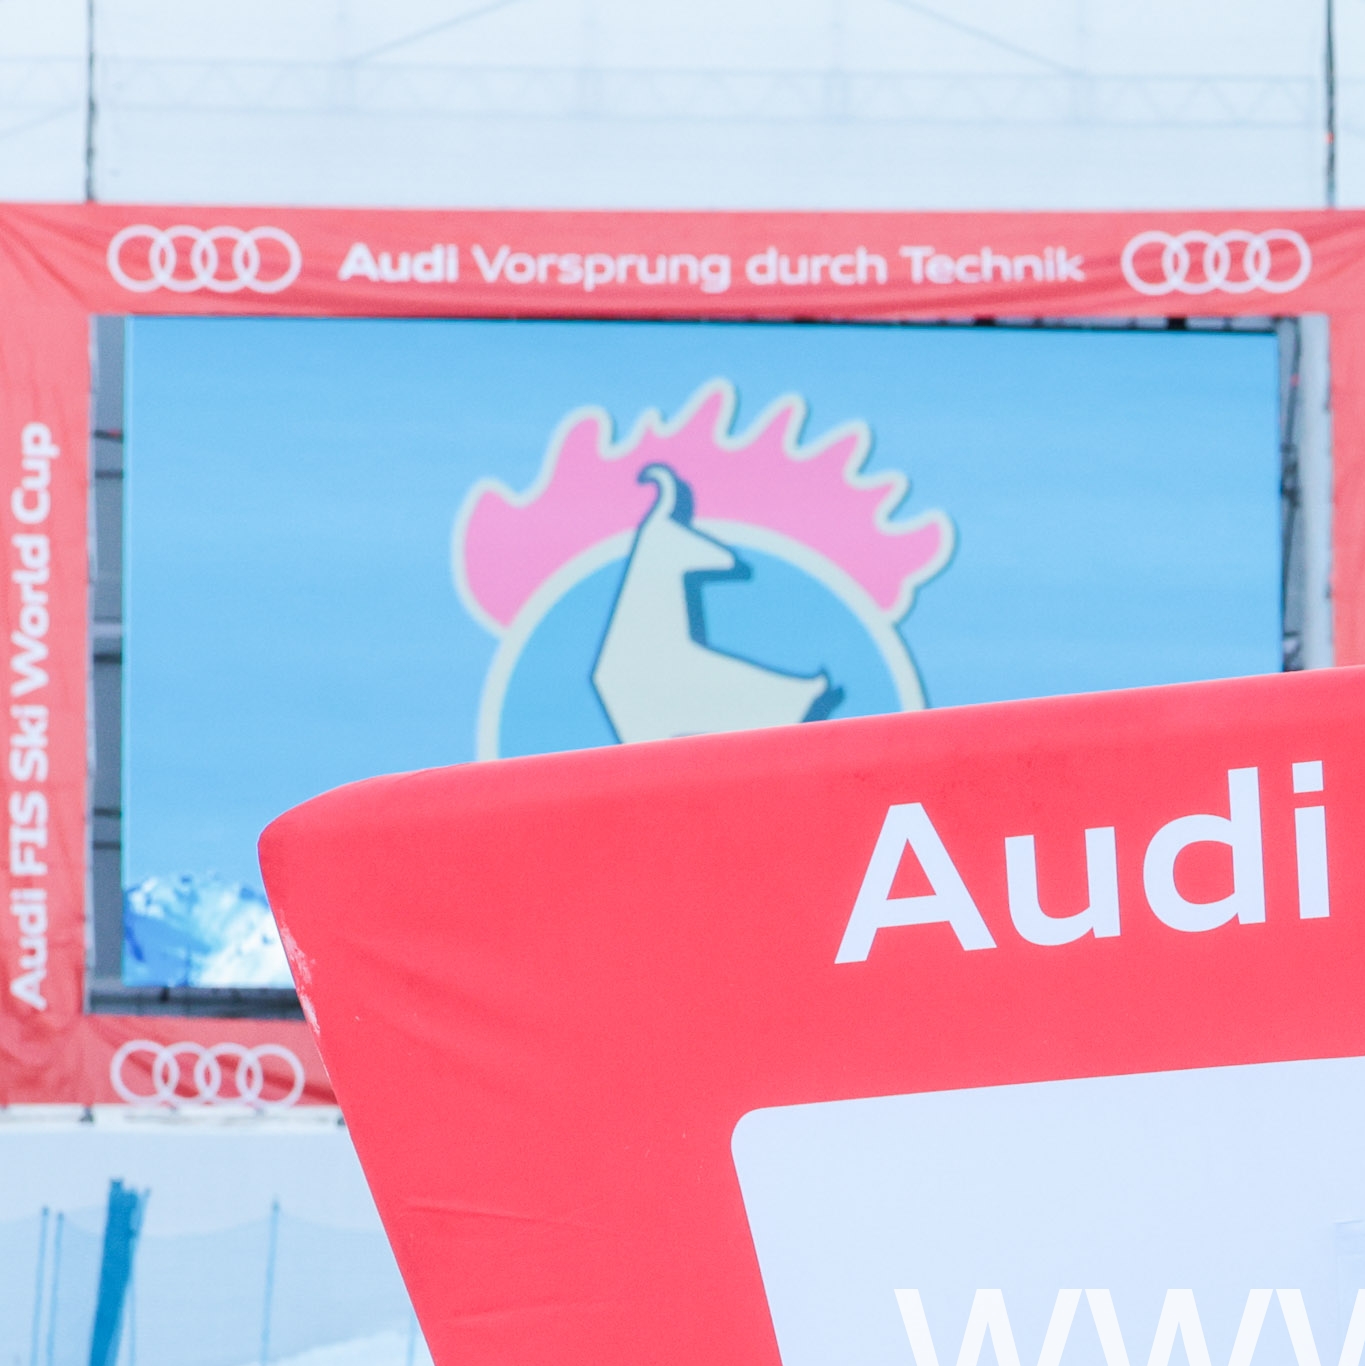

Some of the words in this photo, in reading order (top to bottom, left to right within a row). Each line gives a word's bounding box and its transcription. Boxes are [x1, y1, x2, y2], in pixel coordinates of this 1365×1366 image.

[339, 243, 457, 283] Audi
[472, 245, 730, 292] Vorsprung
[747, 246, 886, 285] durch
[901, 247, 1085, 283] Technik
[11, 422, 60, 524] Cup
[10, 533, 51, 696] World
[10, 704, 49, 782] Ski
[9, 793, 48, 876] FIS
[834, 760, 1330, 964] Audi
[10, 888, 48, 1012] Audi
